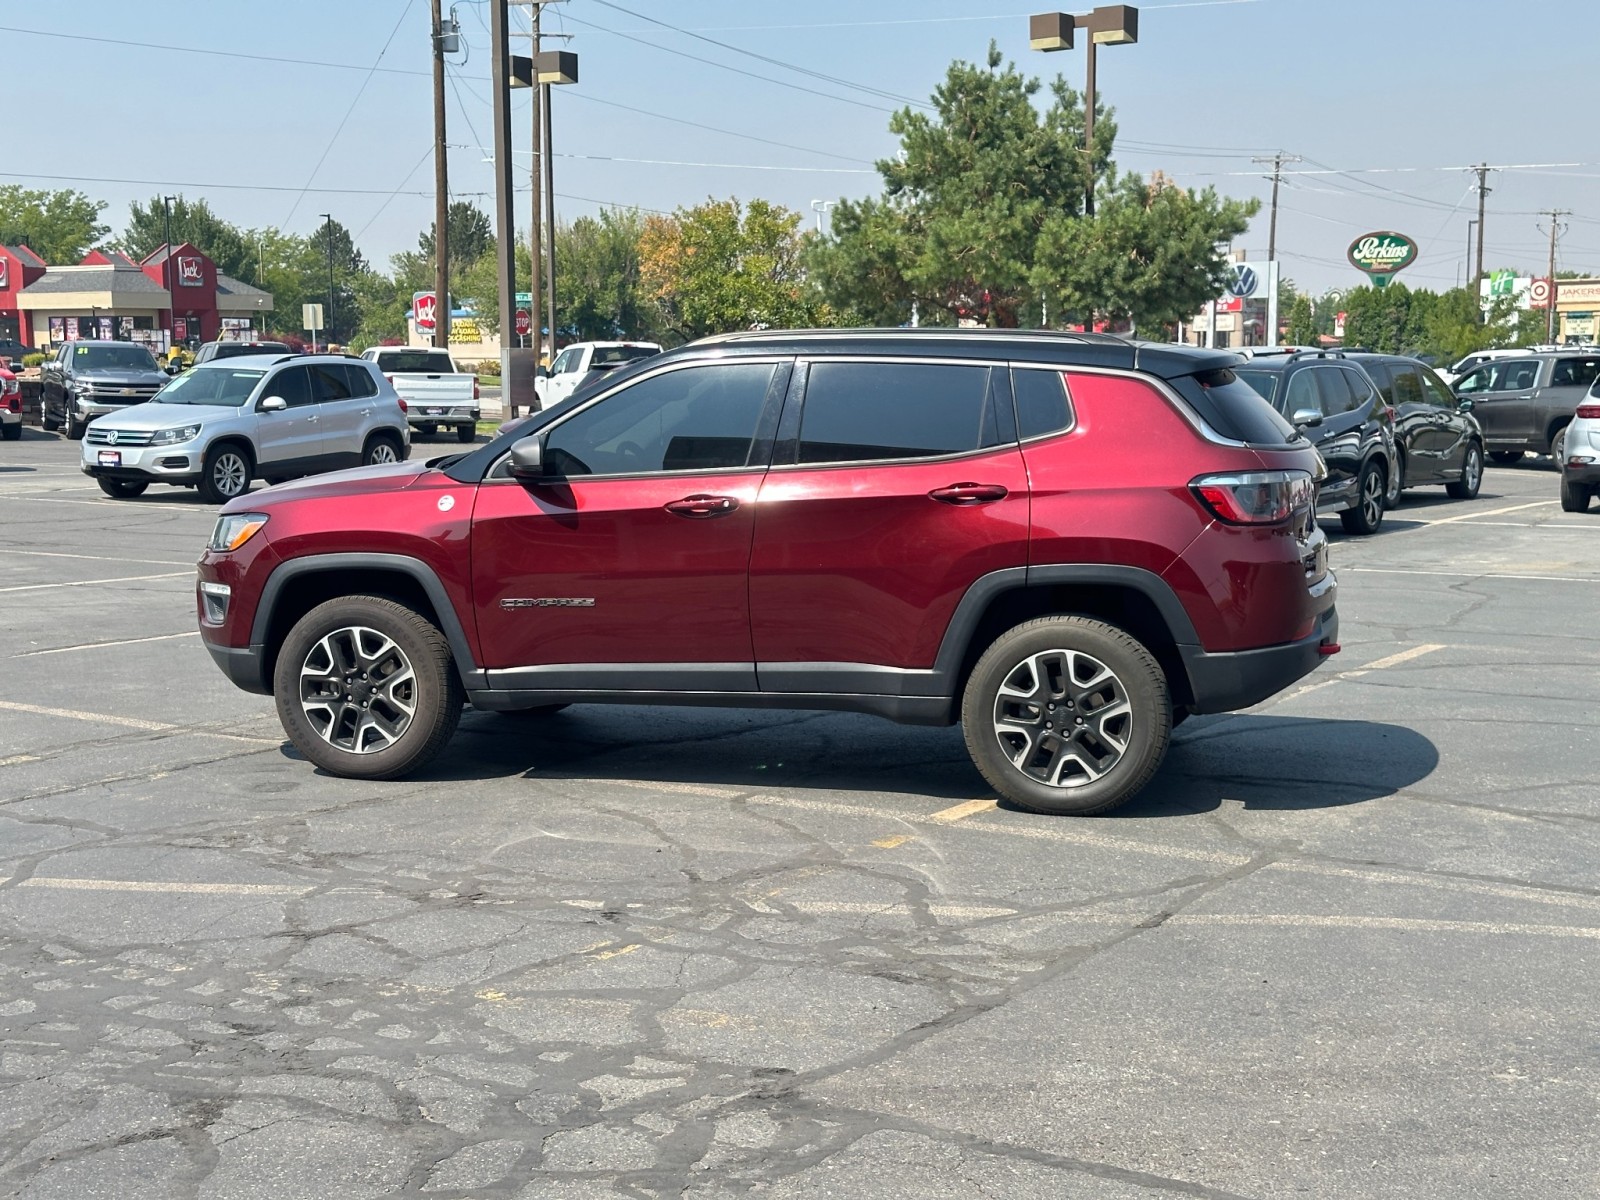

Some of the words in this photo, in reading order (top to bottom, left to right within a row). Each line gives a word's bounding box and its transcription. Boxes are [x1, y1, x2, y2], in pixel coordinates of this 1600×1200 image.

[1353, 237, 1409, 259] Perkins
[183, 261, 203, 279] Jack
[416, 298, 436, 323] Jack
[516, 318, 529, 328] STOP
[500, 597, 595, 607] COMPASS
